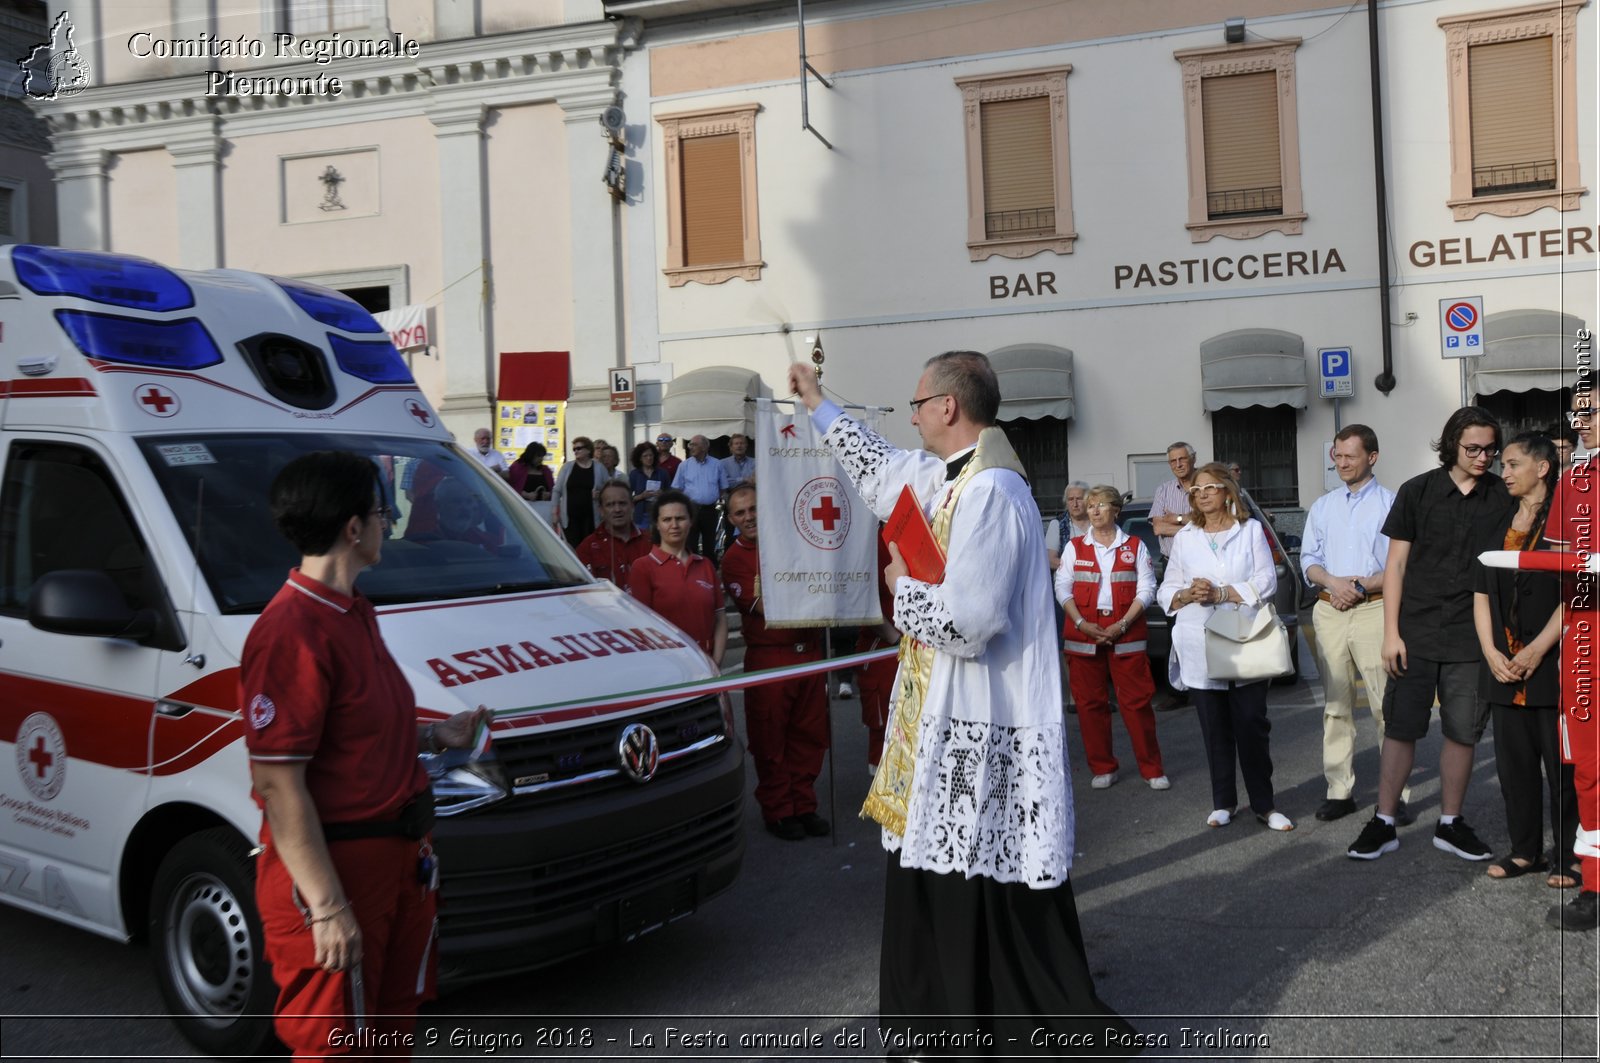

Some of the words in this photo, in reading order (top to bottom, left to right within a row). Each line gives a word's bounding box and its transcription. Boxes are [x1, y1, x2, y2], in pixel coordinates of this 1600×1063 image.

[990, 271, 1058, 299] BAR
[1114, 248, 1347, 290] PASTICCERIA
[1449, 337, 1457, 347] P
[1327, 354, 1343, 374] P
[769, 447, 801, 458] CROCE
[774, 571, 832, 583] COMITATO
